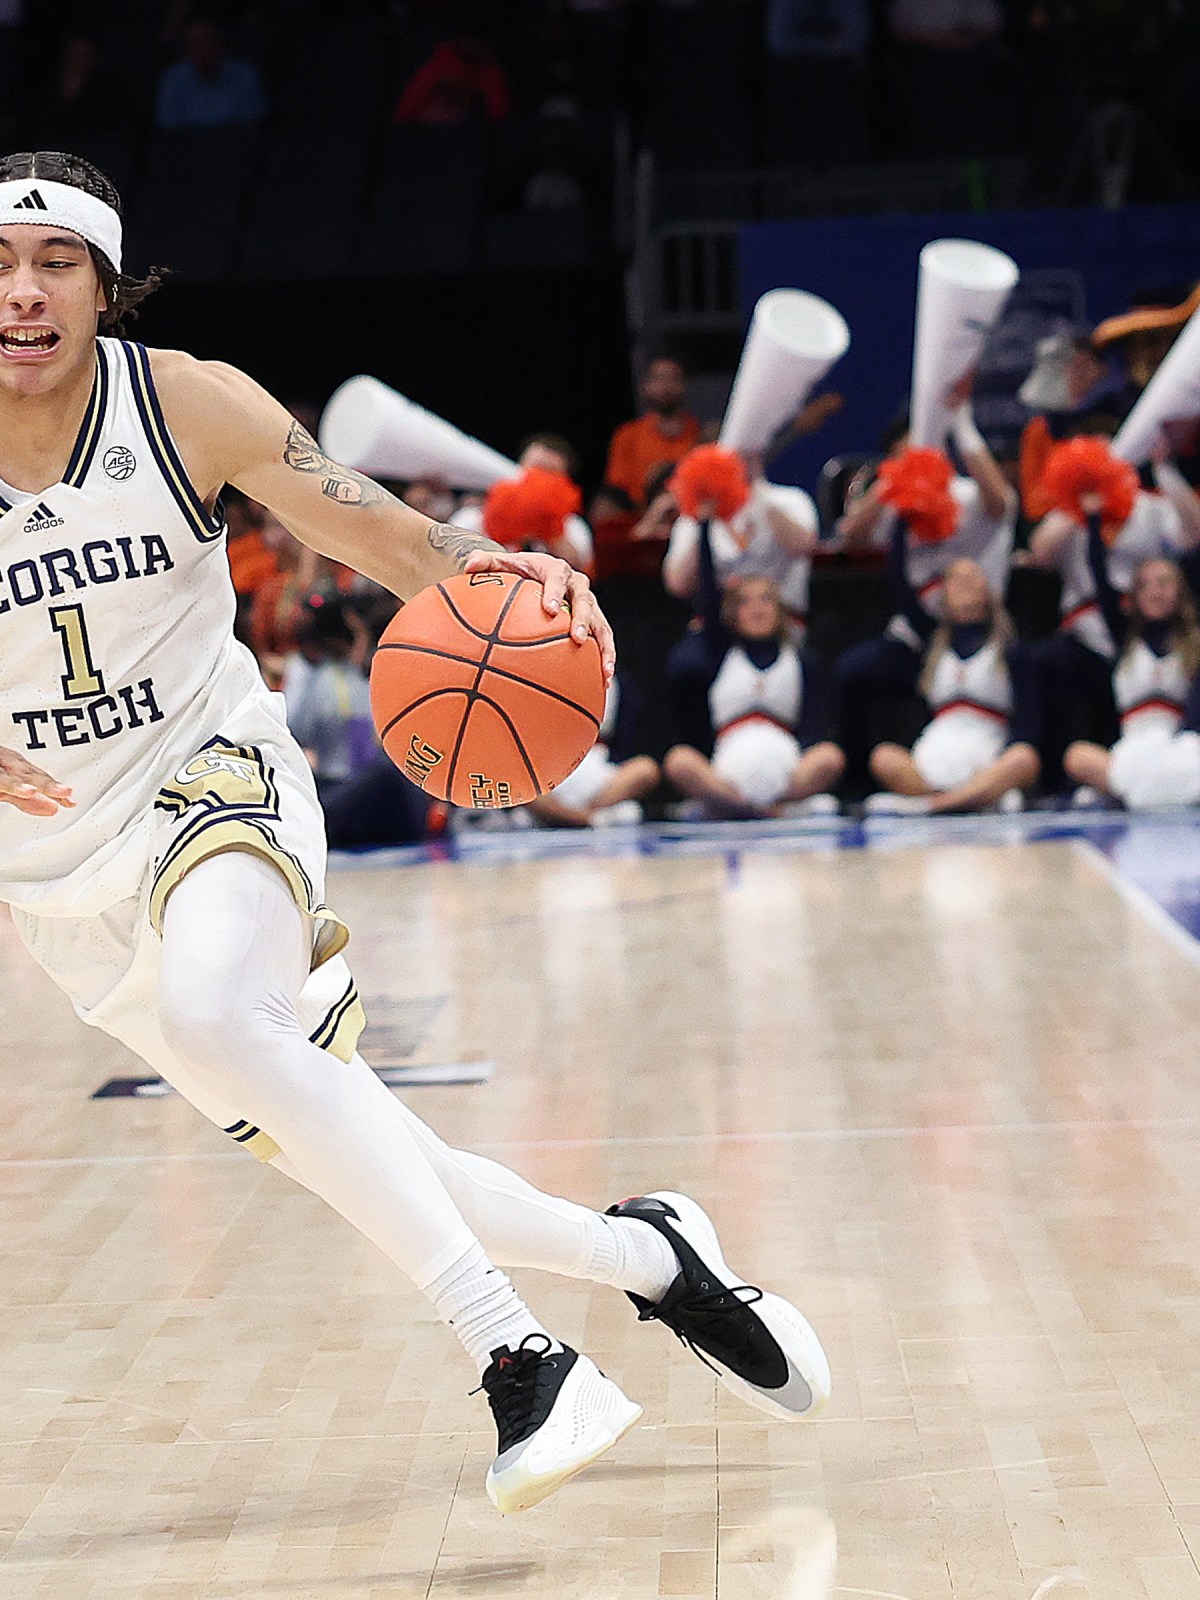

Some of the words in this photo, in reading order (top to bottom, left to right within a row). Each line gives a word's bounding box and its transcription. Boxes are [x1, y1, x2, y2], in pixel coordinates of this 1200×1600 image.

[108, 454, 133, 468] ACC
[23, 517, 65, 533] adidas
[49, 603, 105, 701] 1
[12, 677, 165, 750] TECH
